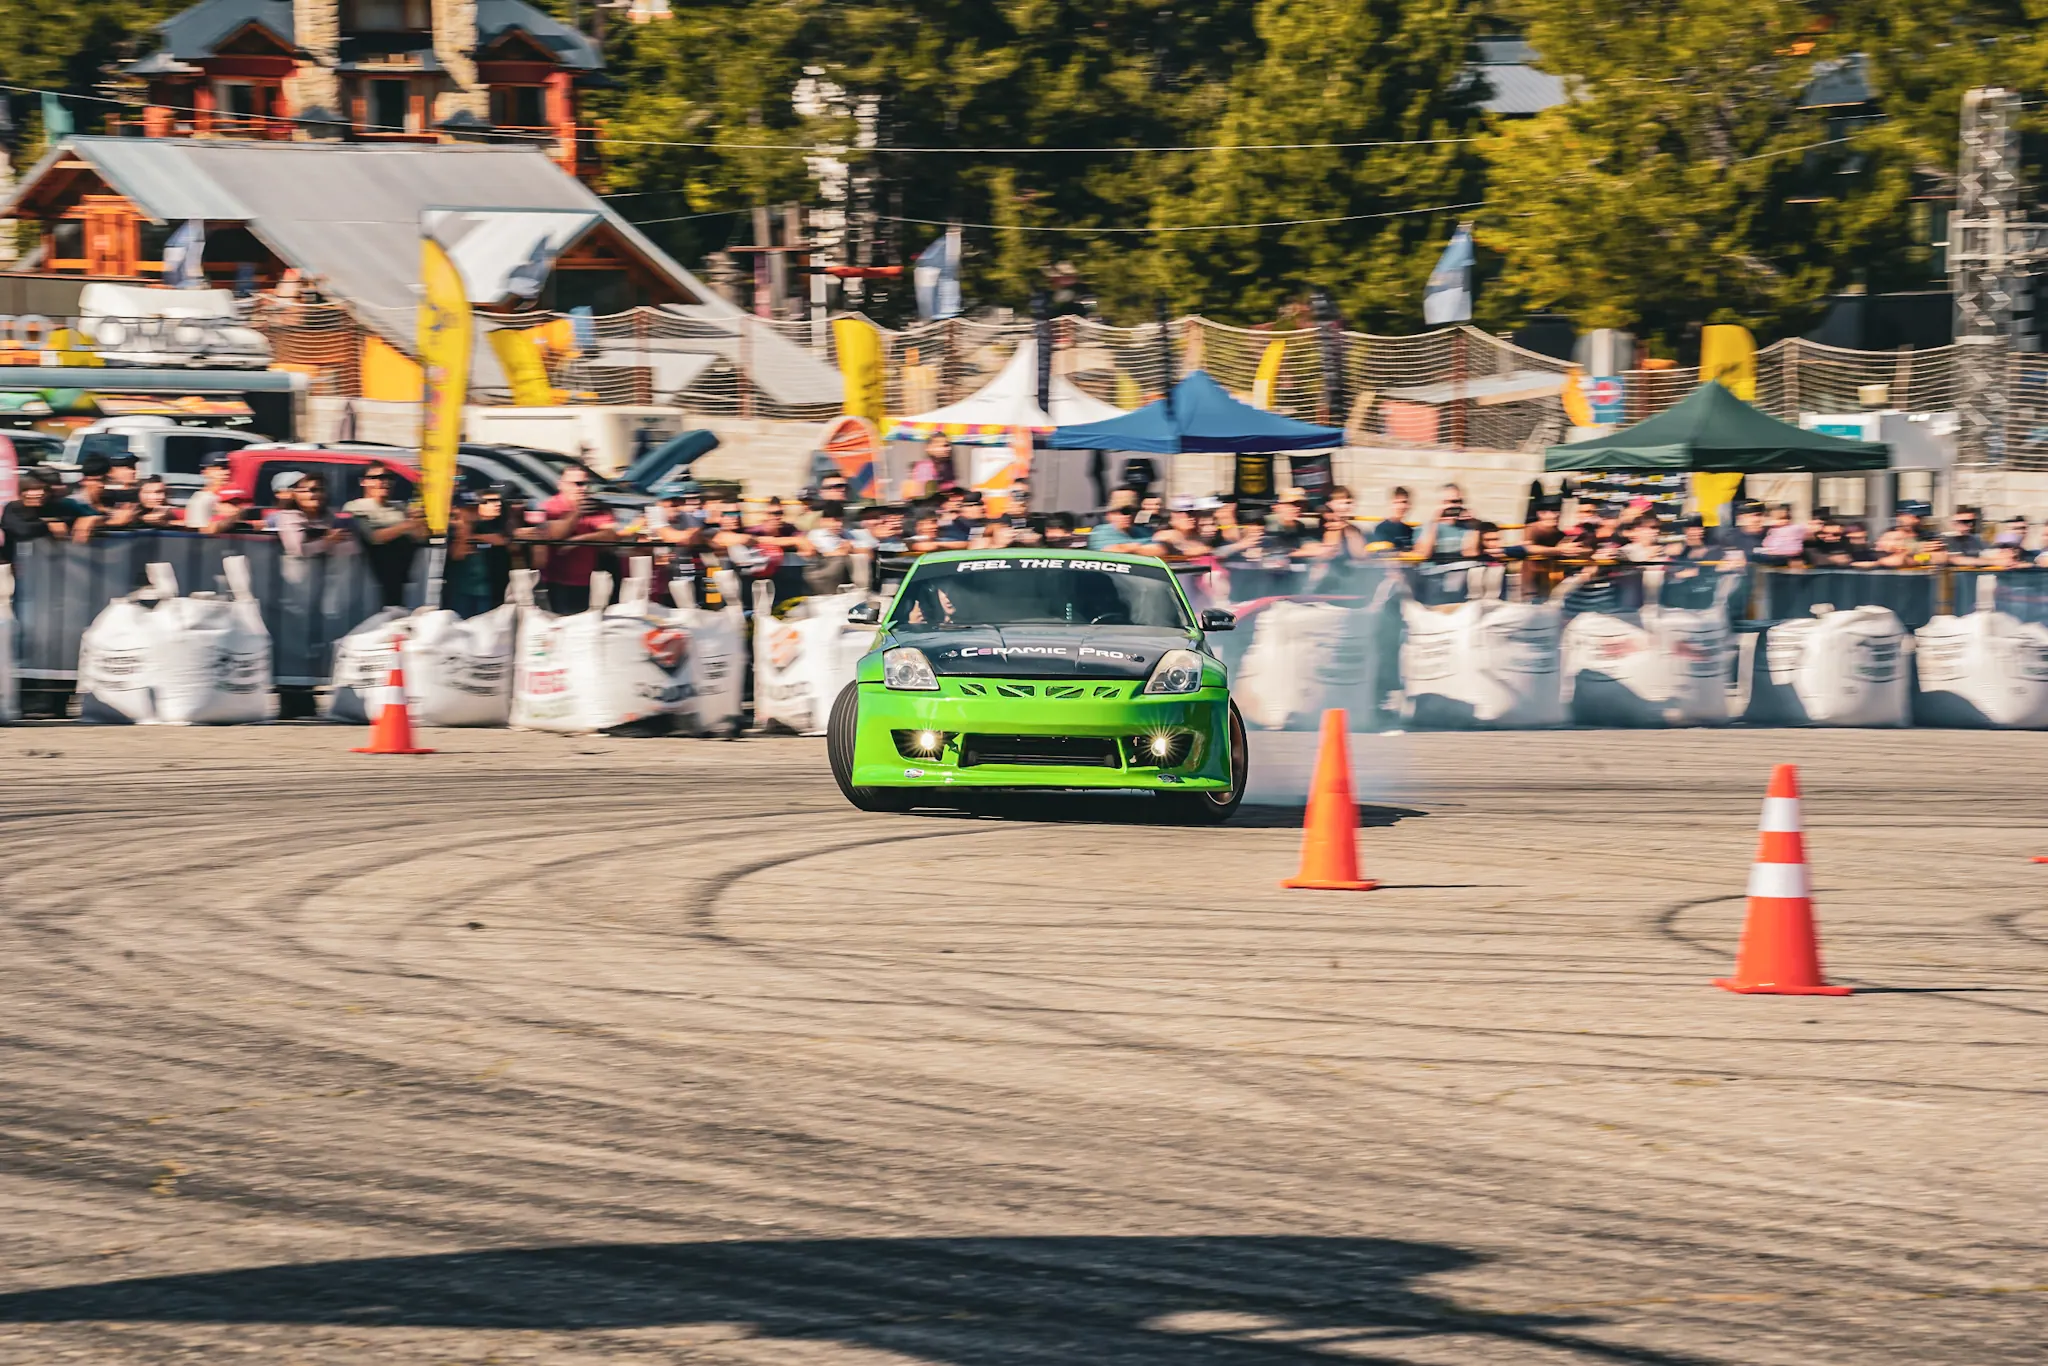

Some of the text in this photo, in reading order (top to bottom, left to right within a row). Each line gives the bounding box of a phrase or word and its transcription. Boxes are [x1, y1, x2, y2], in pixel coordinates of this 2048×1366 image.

[957, 559, 1132, 573] FEEL THE RACE
